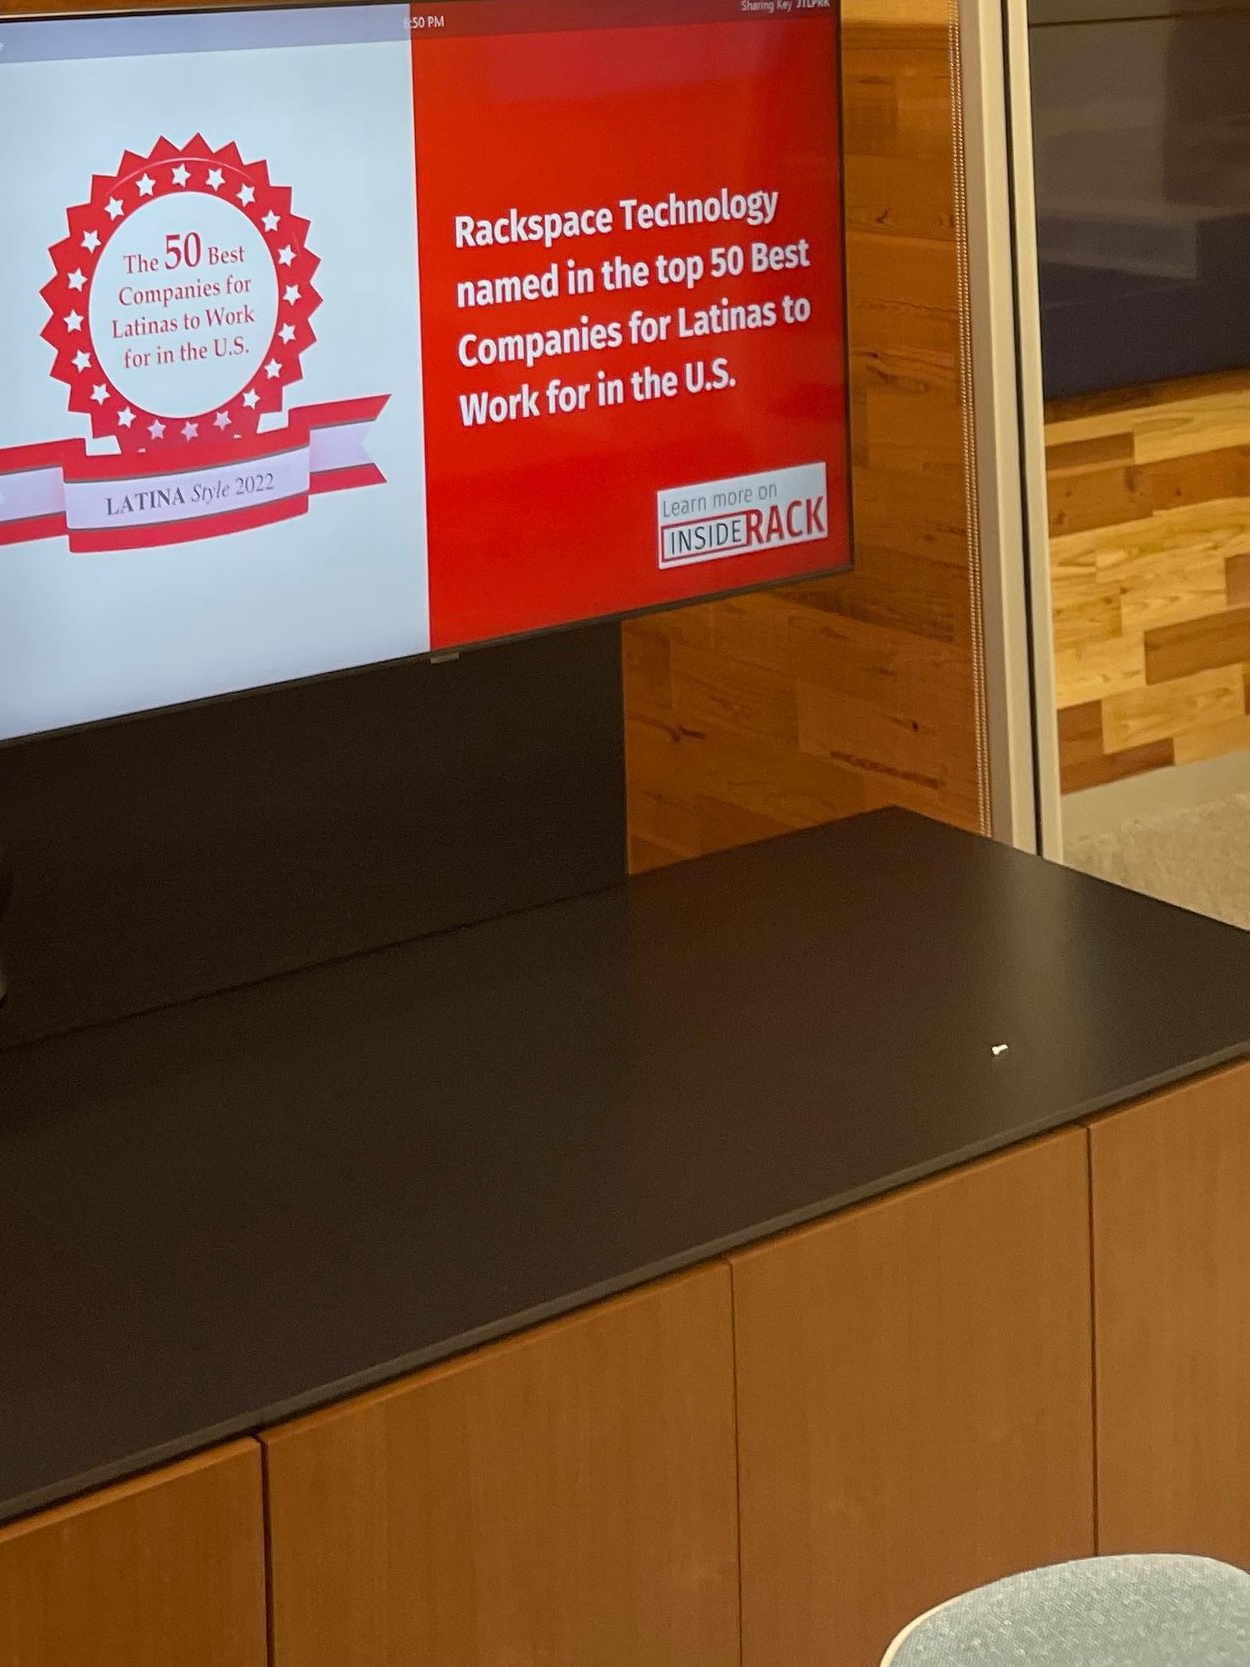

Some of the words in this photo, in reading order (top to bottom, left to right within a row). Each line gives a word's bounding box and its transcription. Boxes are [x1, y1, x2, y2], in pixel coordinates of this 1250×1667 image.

[427, 15, 445, 28] PM
[741, 0, 775, 14] Sharing
[454, 207, 613, 249] Rackspace
[619, 187, 779, 231] Technology
[123, 253, 159, 274] The
[164, 231, 202, 270] 50
[208, 245, 245, 265] Best
[118, 278, 221, 308] Companies
[225, 274, 252, 295] for
[456, 262, 559, 309] named
[566, 258, 594, 295] in
[601, 255, 650, 291] the
[655, 254, 704, 289] top
[710, 244, 744, 278] 50
[751, 238, 811, 273] Best
[111, 316, 179, 339] Latinas
[183, 313, 201, 331] to
[205, 304, 256, 328] Work
[458, 314, 623, 368] Companies
[628, 310, 672, 345] for
[677, 296, 777, 339] Latinas
[781, 294, 812, 325] to
[124, 348, 151, 369] for
[156, 345, 175, 365] in
[180, 341, 208, 362] the
[213, 335, 250, 358] U.S.
[458, 383, 541, 428] Work
[545, 379, 591, 415] for
[597, 370, 625, 408] in
[630, 365, 679, 403] the
[685, 357, 737, 394] U.S.
[105, 486, 186, 516] LATINA
[190, 481, 231, 505] Style
[234, 472, 276, 496] 2022
[662, 496, 708, 518] Learn
[712, 488, 754, 509] more
[757, 483, 779, 501] on
